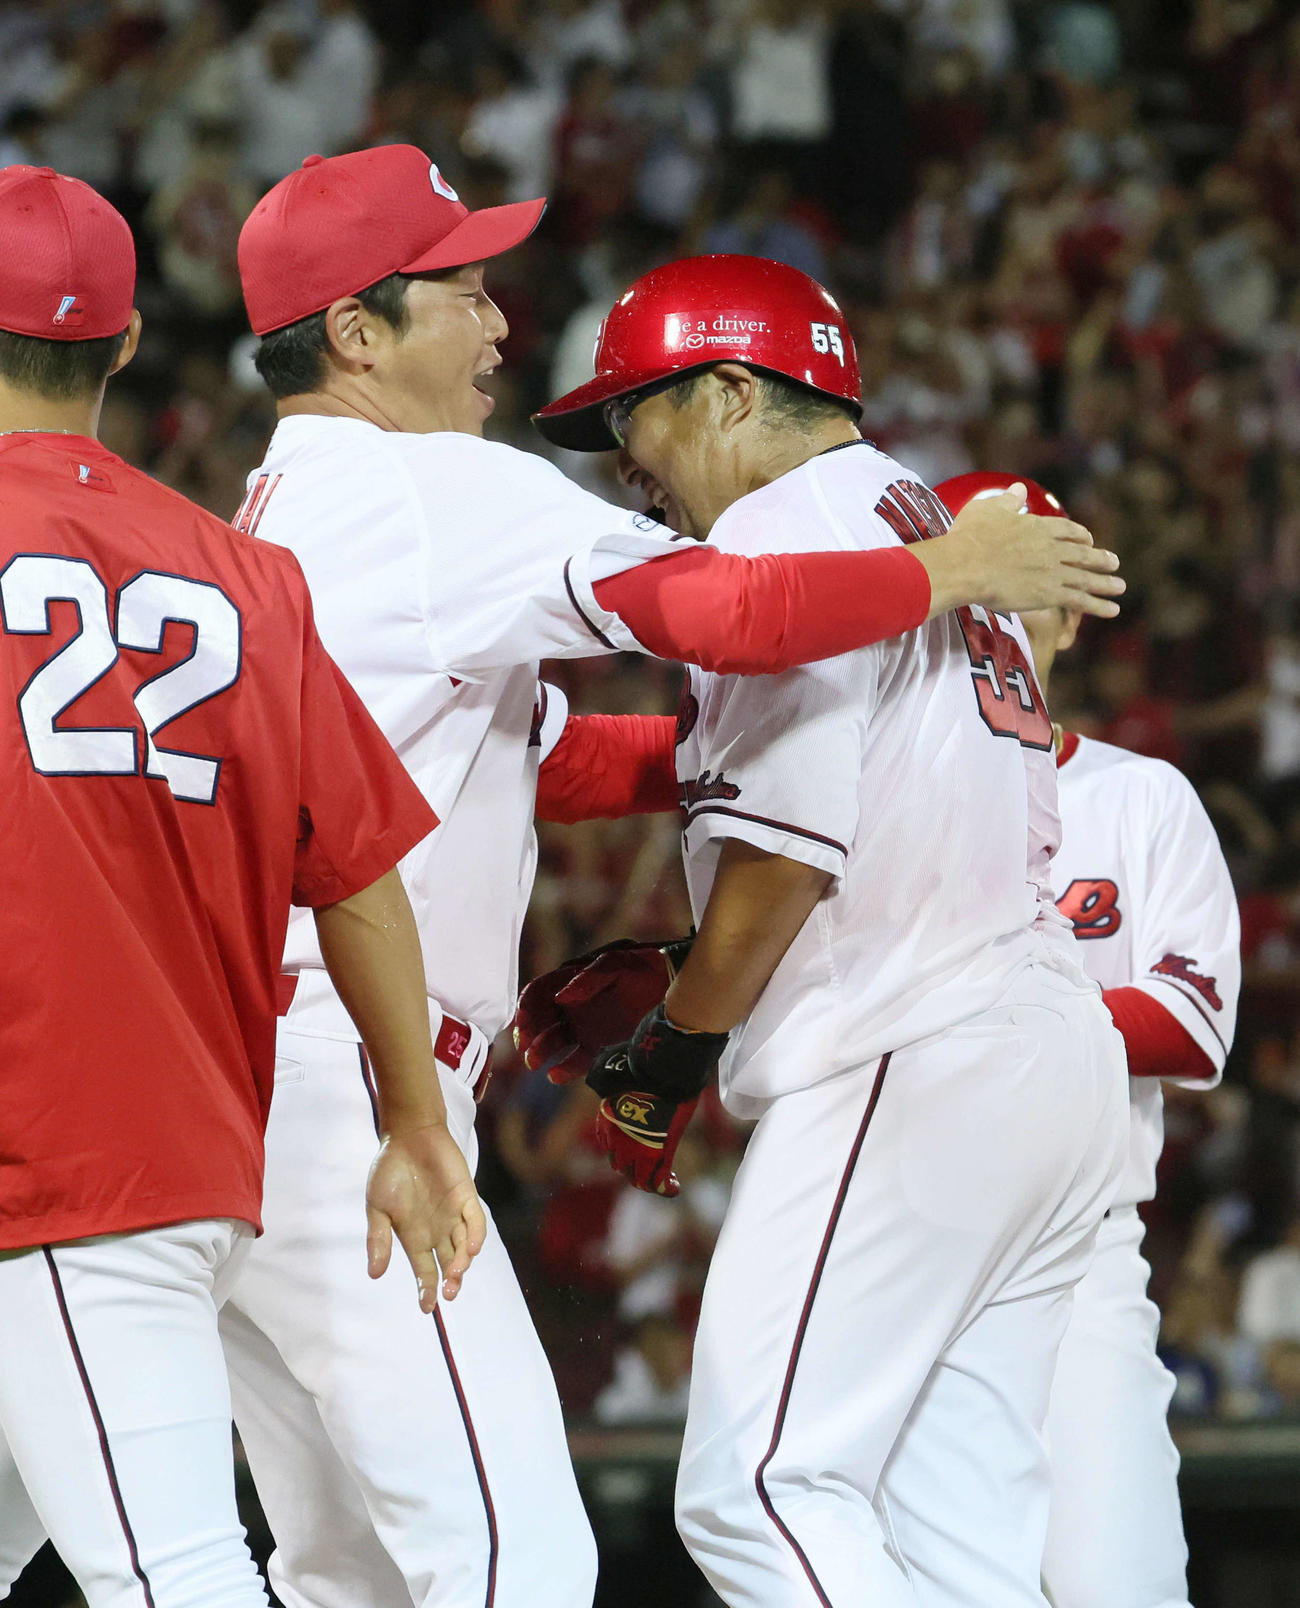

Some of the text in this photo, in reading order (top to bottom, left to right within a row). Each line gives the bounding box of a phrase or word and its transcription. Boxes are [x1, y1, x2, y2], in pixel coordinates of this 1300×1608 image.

[696, 319, 707, 332] a
[712, 315, 771, 333] driver.
[809, 321, 845, 368] 55
[0, 552, 243, 806] 22
[447, 1031, 468, 1059] 25
